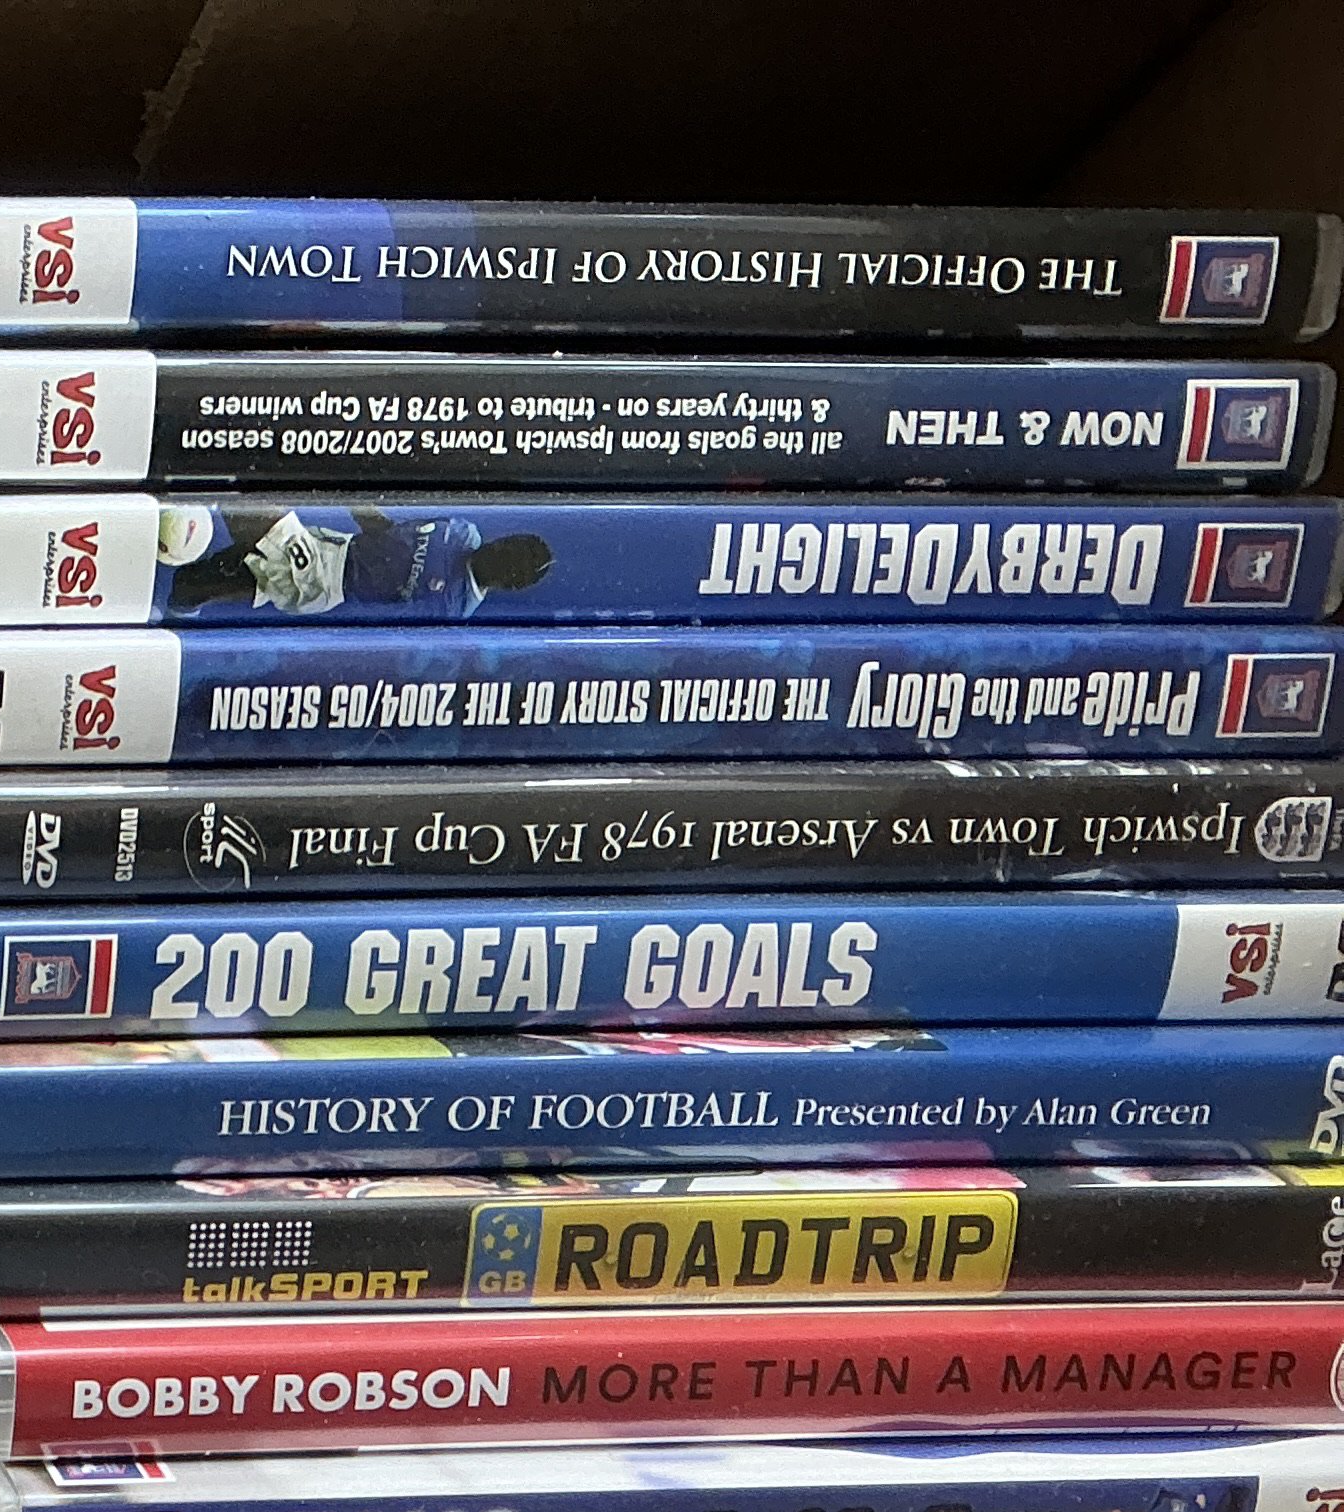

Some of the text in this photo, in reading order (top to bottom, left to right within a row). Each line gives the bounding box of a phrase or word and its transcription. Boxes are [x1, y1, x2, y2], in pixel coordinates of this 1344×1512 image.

[228, 244, 1123, 296] THE OFFICIAL HISTORY OF IPSWICH TOWN
[199, 391, 728, 422] years on tribute 1978 FA Cup winners
[886, 409, 1047, 447] & THEN
[181, 425, 843, 455] all the goals from Ipswich 2007/2008 season
[328, 677, 832, 729] THE OFFICIAL STORY THE 2004/05
[846, 662, 1202, 740] Pride and the Glory
[114, 808, 139, 882] DVD2513
[287, 804, 1245, 870] Ipswich Town vs Cup Final
[150, 921, 878, 1019] 200 GREAT GOALS
[218, 1090, 1212, 1136] HISTORY OF FOOTBALL Presented Alan Green
[553, 1213, 995, 1292] ROADTRIP
[181, 1269, 430, 1304] talkSPORT
[71, 1351, 1297, 1420] BOBBY ROBSON THAN A MANAGER
